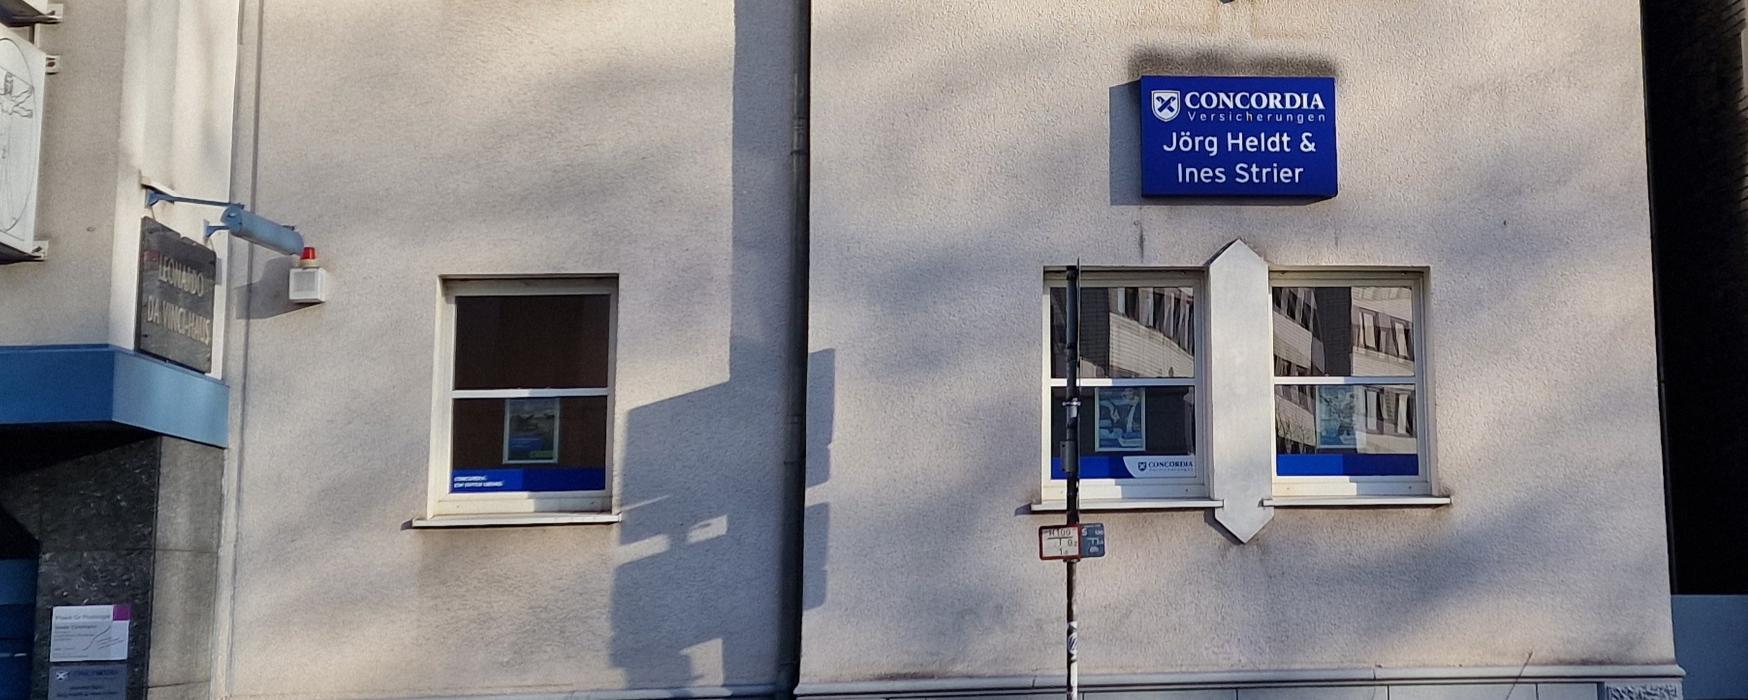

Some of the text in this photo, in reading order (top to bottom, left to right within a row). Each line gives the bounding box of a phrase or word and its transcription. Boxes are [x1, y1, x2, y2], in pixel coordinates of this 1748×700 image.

[1184, 91, 1326, 110] CONCORDIA
[1187, 111, 1326, 124] Versicherungen
[1162, 131, 1316, 157] Jörg Heldt &
[1177, 163, 1304, 184] Ines Strier
[158, 255, 204, 297] LEONARDO
[147, 295, 160, 324] DA
